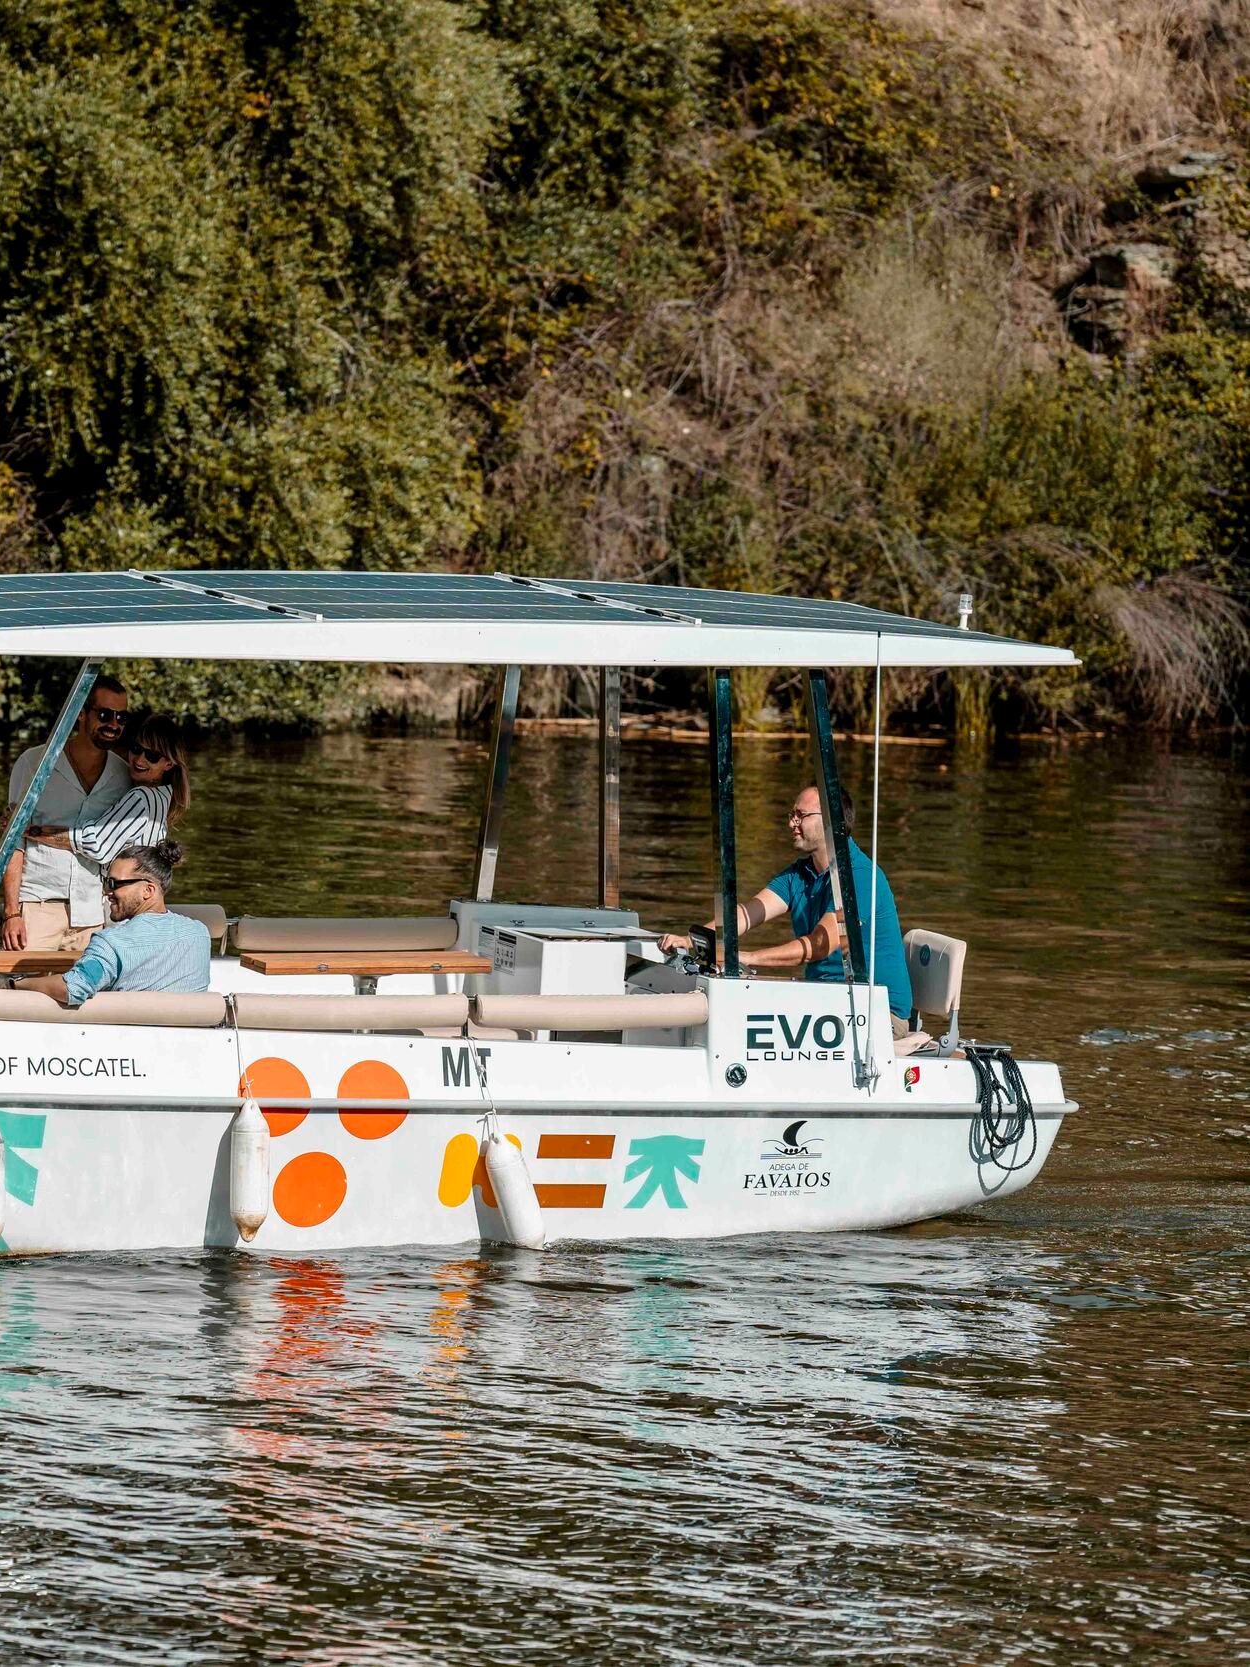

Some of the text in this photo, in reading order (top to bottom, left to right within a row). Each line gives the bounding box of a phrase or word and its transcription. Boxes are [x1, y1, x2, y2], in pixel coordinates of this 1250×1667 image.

[746, 1014, 846, 1050] EVO
[746, 1051, 846, 1061] LOUNGE
[27, 1057, 148, 1078] MOSCATEL.
[441, 1046, 492, 1088] MT
[769, 1162, 810, 1171] ADEGA DE
[743, 1171, 831, 1189] FAVAIOS
